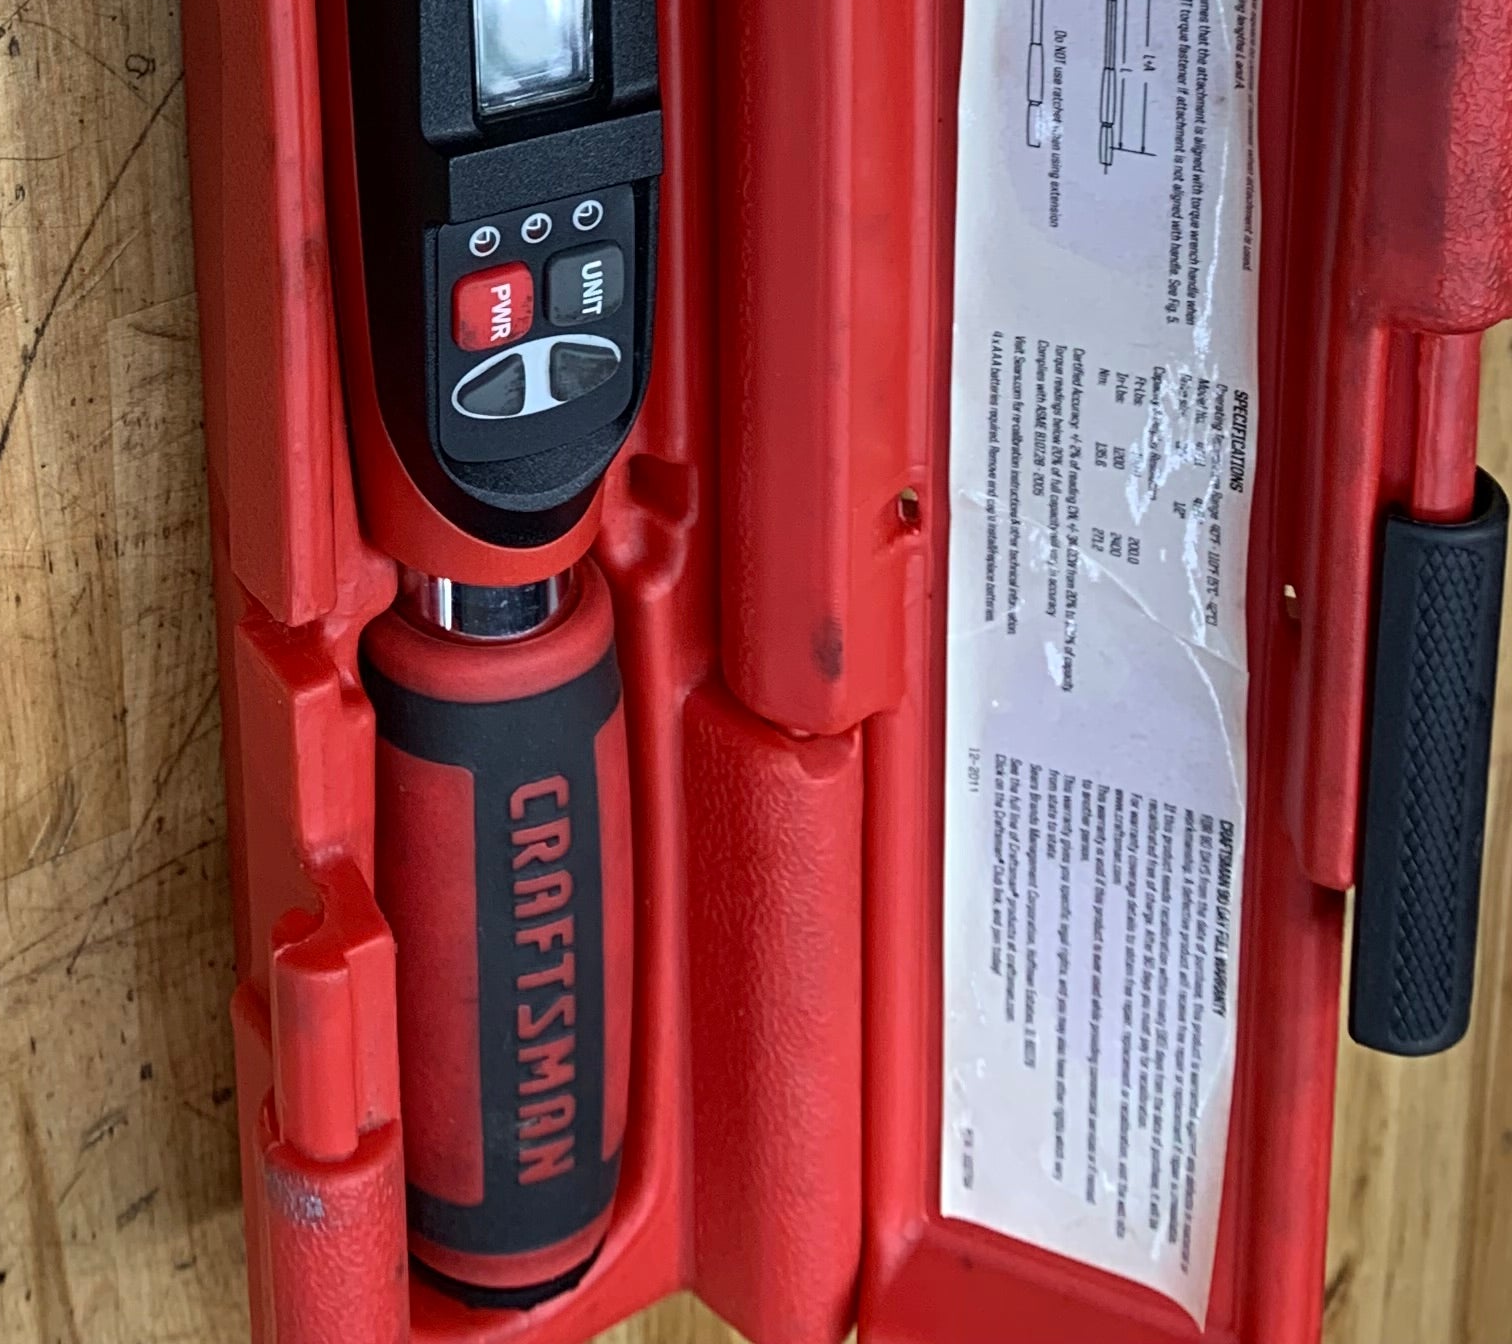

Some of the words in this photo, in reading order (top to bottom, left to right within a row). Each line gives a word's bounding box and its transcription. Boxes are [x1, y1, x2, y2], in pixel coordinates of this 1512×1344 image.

[1054, 30, 1068, 43] Do
[1054, 45, 1067, 65] NOT
[1053, 66, 1063, 85] use
[1048, 152, 1063, 179] using
[1049, 181, 1062, 228] extension
[582, 260, 603, 315] UNIT
[490, 284, 511, 342] PWR
[1230, 389, 1249, 493] SPECIFICATIONS
[508, 775, 575, 1186] CRAFTSMAN
